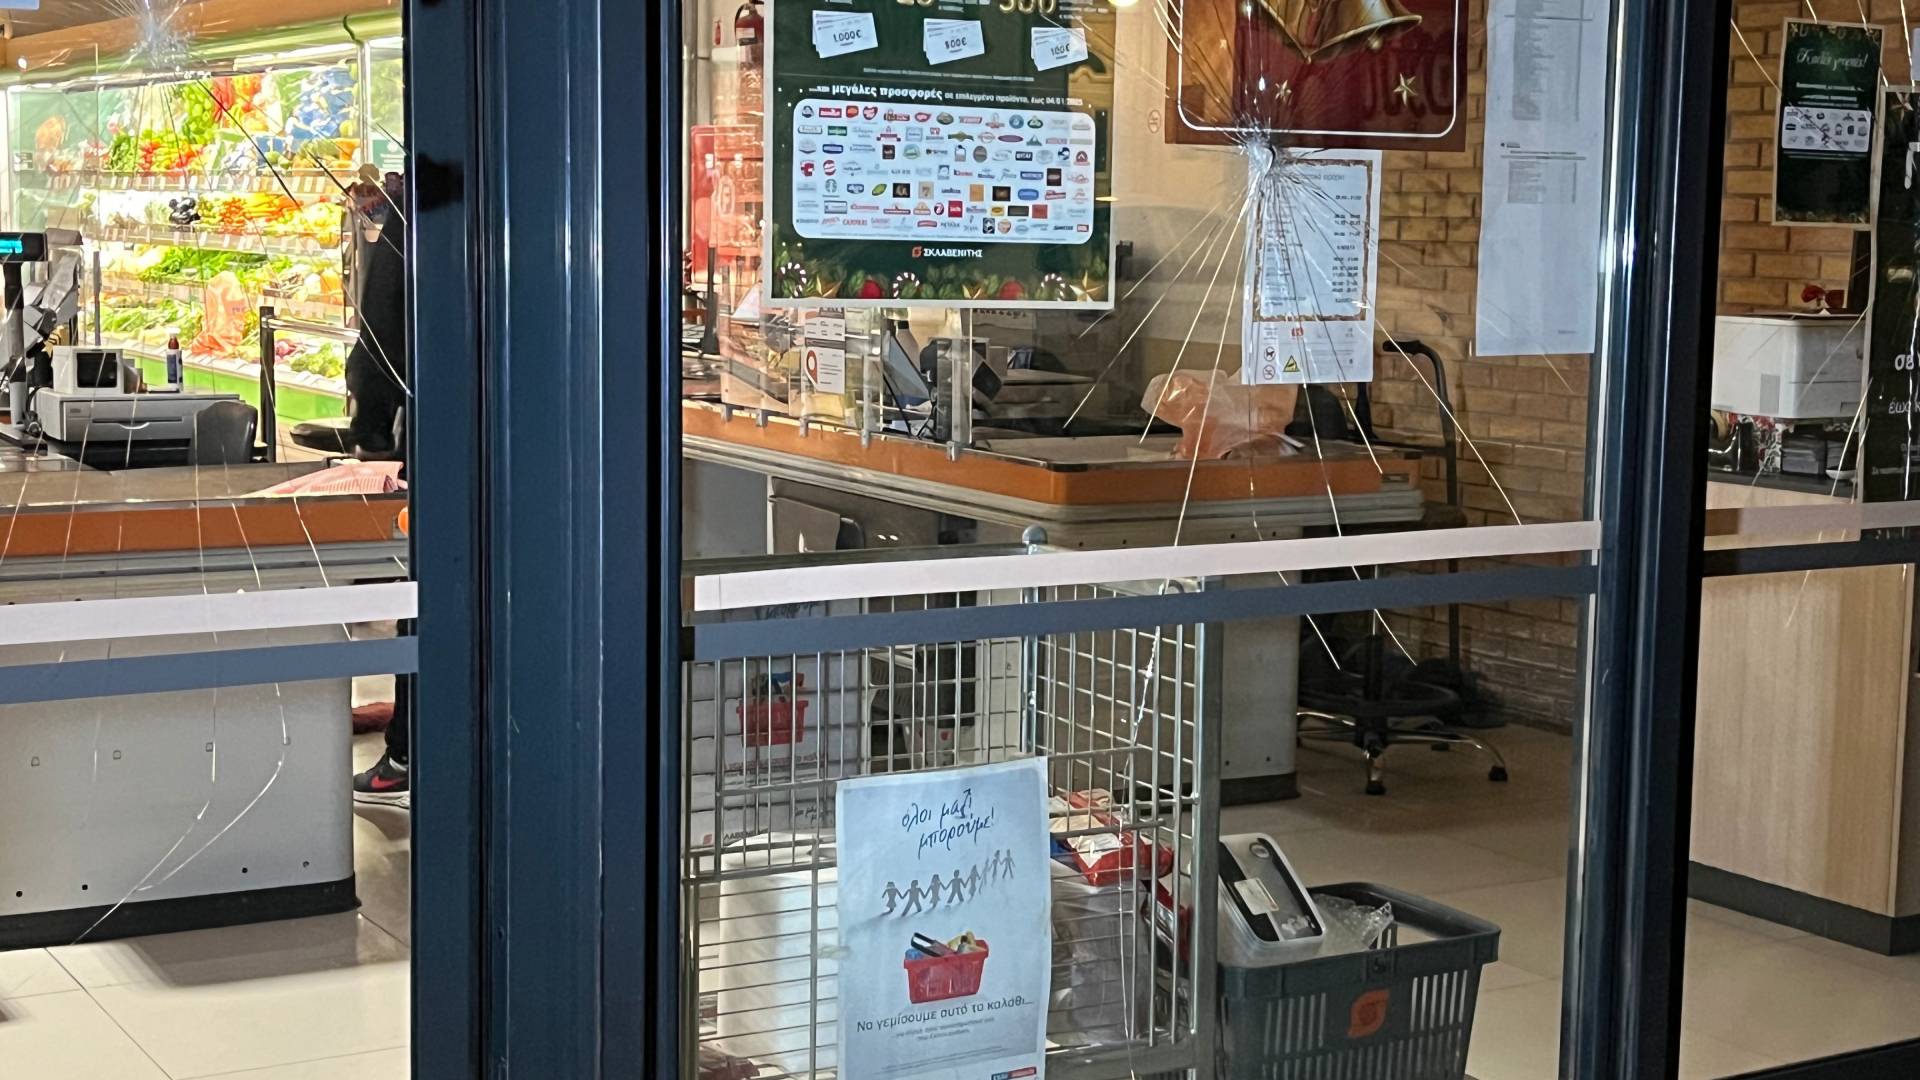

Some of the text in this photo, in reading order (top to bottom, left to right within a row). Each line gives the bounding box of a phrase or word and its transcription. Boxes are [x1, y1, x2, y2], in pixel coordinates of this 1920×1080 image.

[832, 83, 877, 97] μεγάλες
[879, 87, 943, 100] προσφορές
[923, 248, 983, 258] ΣΚΛΑΒΕΝΙΤΗΣ
[902, 803, 933, 833] όλοι
[918, 806, 995, 860] μπορούμε!
[857, 1016, 873, 1033] Να
[876, 1008, 937, 1032] γεμίσουμε
[940, 1003, 968, 1018] αυτό
[972, 1003, 984, 1014] το
